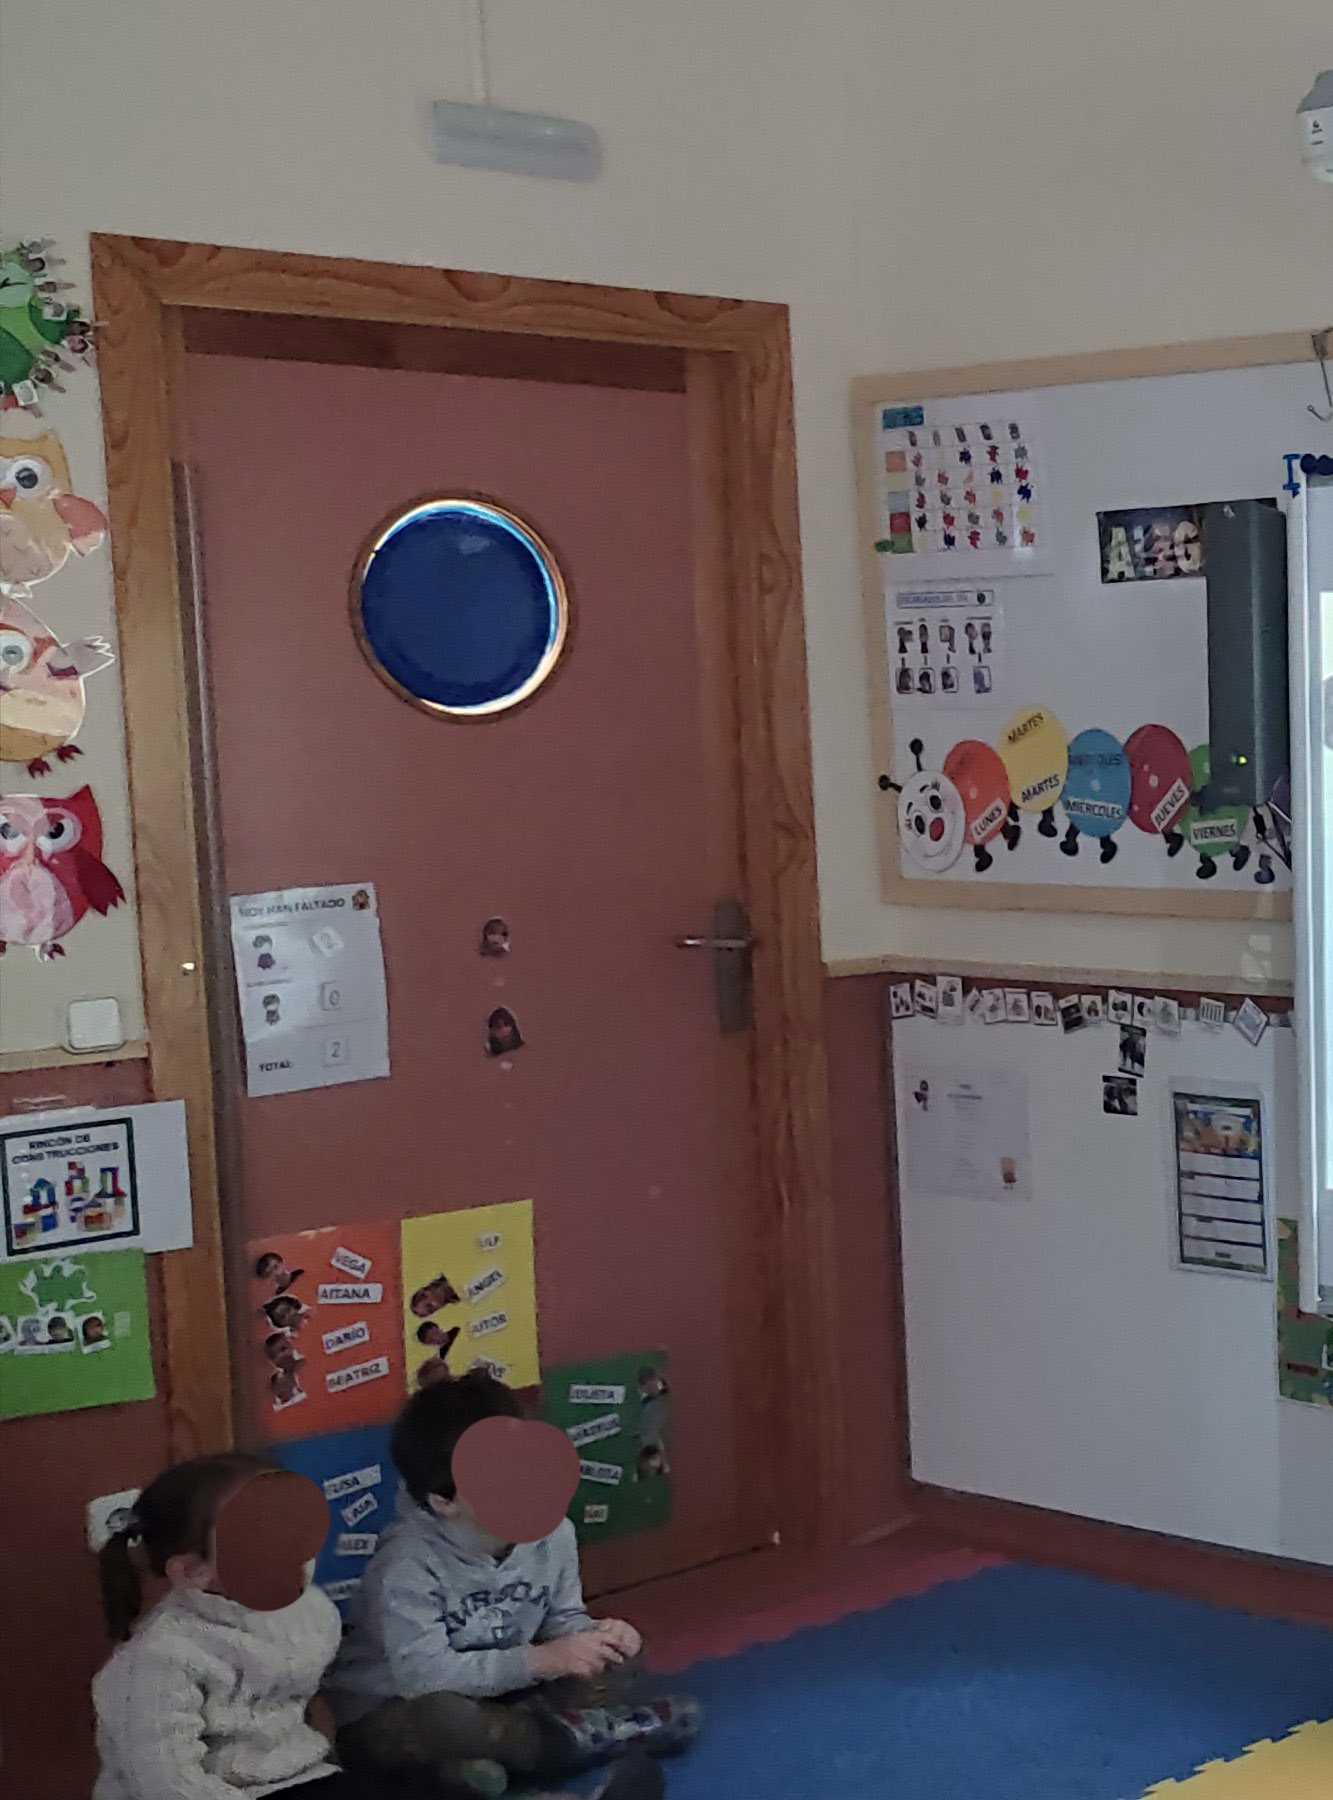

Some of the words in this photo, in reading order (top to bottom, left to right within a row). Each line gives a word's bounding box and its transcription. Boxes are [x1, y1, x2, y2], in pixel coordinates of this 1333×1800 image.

[1008, 712, 1044, 743] MARTES
[1021, 774, 1061, 803] MARTES
[1155, 785, 1185, 826] JUEVES
[975, 805, 1003, 835] LUNES
[1192, 824, 1236, 840] VIERNES
[294, 898, 346, 913] FALTADO
[75, 1133, 91, 1144] DE
[334, 1252, 367, 1274] VEGA
[320, 1287, 372, 1300] AITANA
[328, 1363, 382, 1389] BEATRIZ
